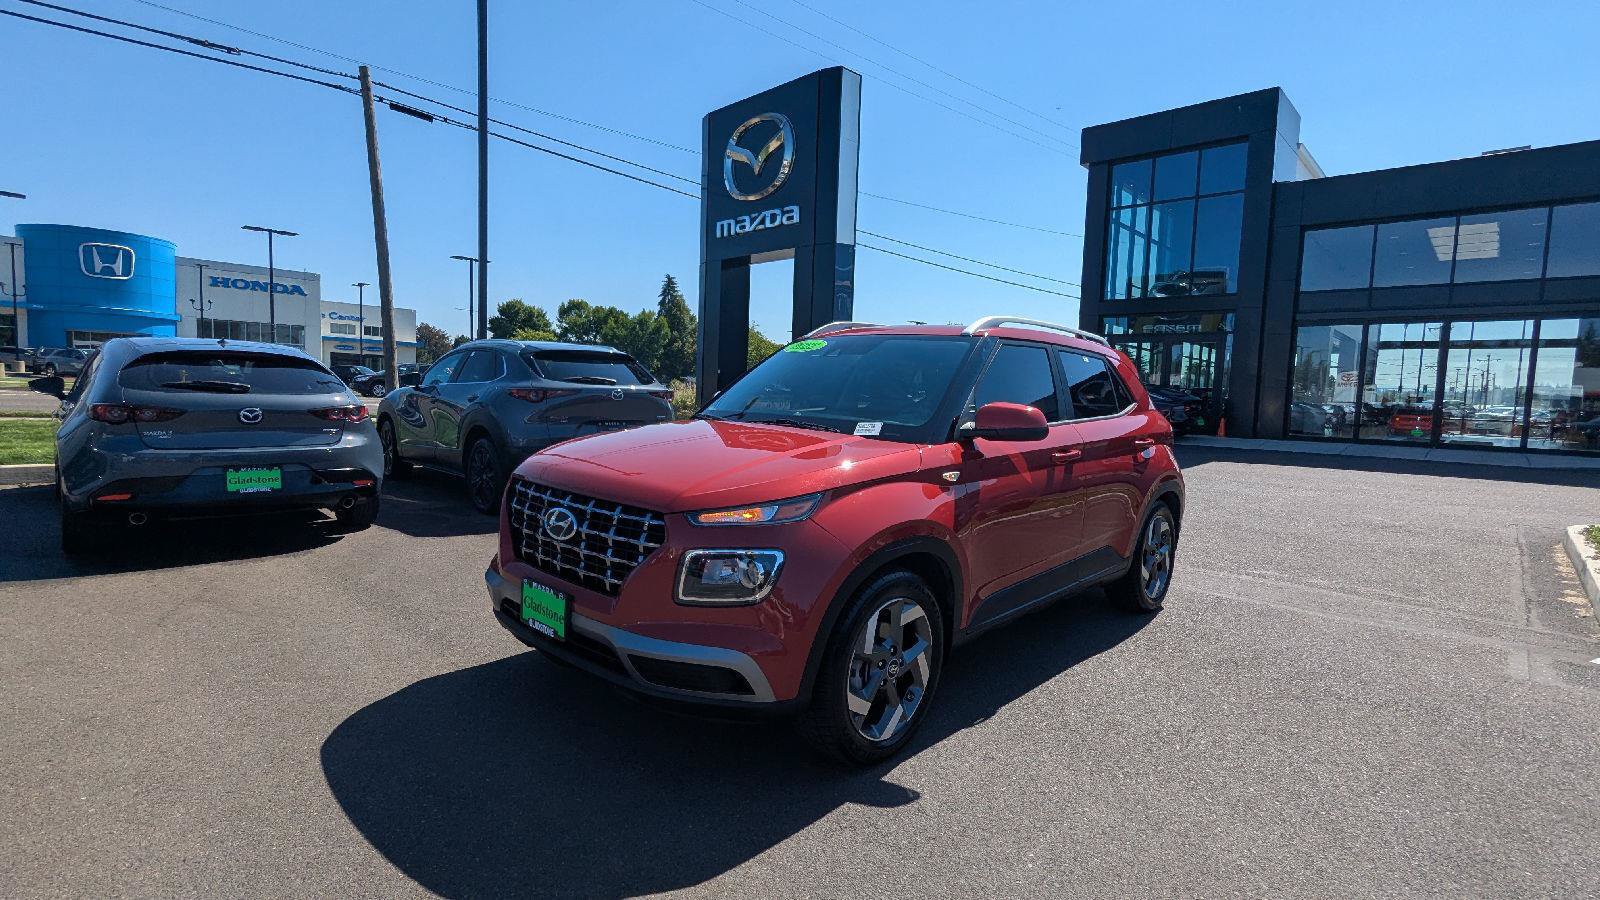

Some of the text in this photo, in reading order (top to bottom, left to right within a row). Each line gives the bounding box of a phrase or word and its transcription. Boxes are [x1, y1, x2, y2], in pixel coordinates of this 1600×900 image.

[716, 205, 800, 239] mazda
[209, 276, 308, 297] HONDA
[229, 476, 280, 485] Gladstone
[532, 582, 554, 595] MAZDA
[524, 595, 564, 624] Gladstone
